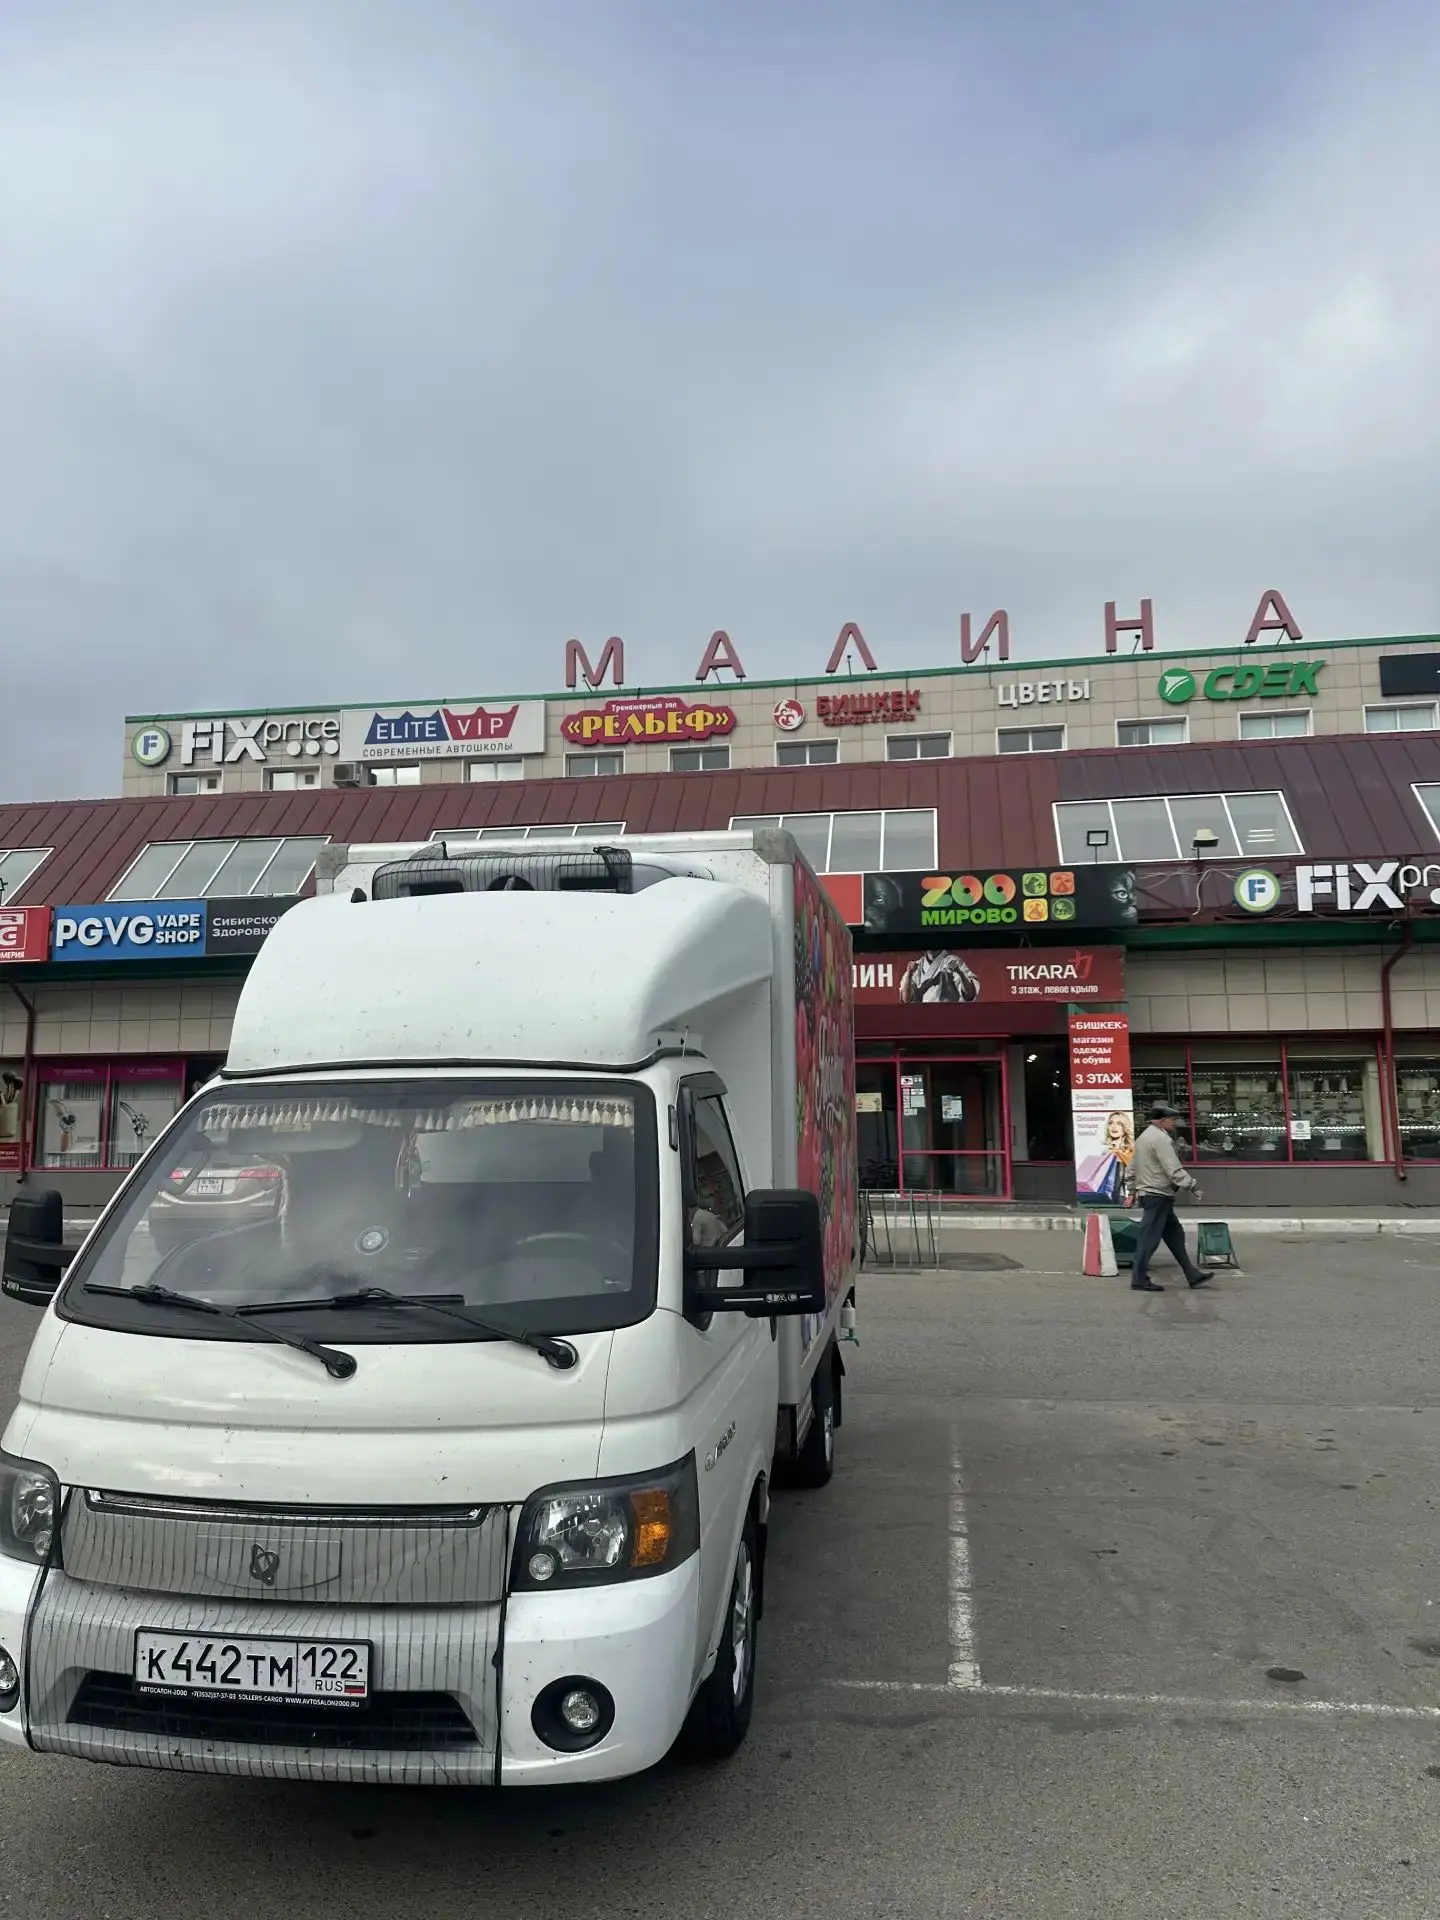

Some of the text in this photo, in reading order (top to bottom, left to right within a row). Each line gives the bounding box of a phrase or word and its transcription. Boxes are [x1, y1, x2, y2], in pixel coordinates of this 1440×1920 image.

[566, 589, 1303, 688] МАЛИНА
[816, 690, 920, 715] БИШКЕК
[998, 679, 1090, 707] ЦВЕТЫ
[264, 719, 340, 747] price
[376, 717, 504, 739] ELITE VIP
[567, 709, 729, 738] «РЕЛЬЕФ»
[362, 742, 513, 757] СОВРЕМЕННЫЕ АВТОШКОЛЫ
[921, 874, 1016, 907] ZOO
[156, 914, 200, 927] VAPE
[921, 908, 1017, 926] МИРОВО
[56, 915, 154, 947] PGVG
[155, 930, 200, 944] SHOP
[853, 963, 893, 987] ИН
[1006, 964, 1078, 980] TIKARA
[1011, 985, 1099, 995] 3 этаж, левое крыло
[1070, 1021, 1127, 1030] «БИШКЕК»
[1082, 1055, 1111, 1066] обуви
[1075, 1073, 1124, 1084] 3 ЭТАЖ
[148, 1642, 358, 1687] К442ТМ 122
[139, 1686, 187, 1697] АВТОСАЛОН-2000
[238, 1693, 283, 1703] SOLLERS-CARGO
[284, 1696, 360, 1708] WWW.AVTOSALON2000.RU
[315, 1680, 343, 1692] RUS
